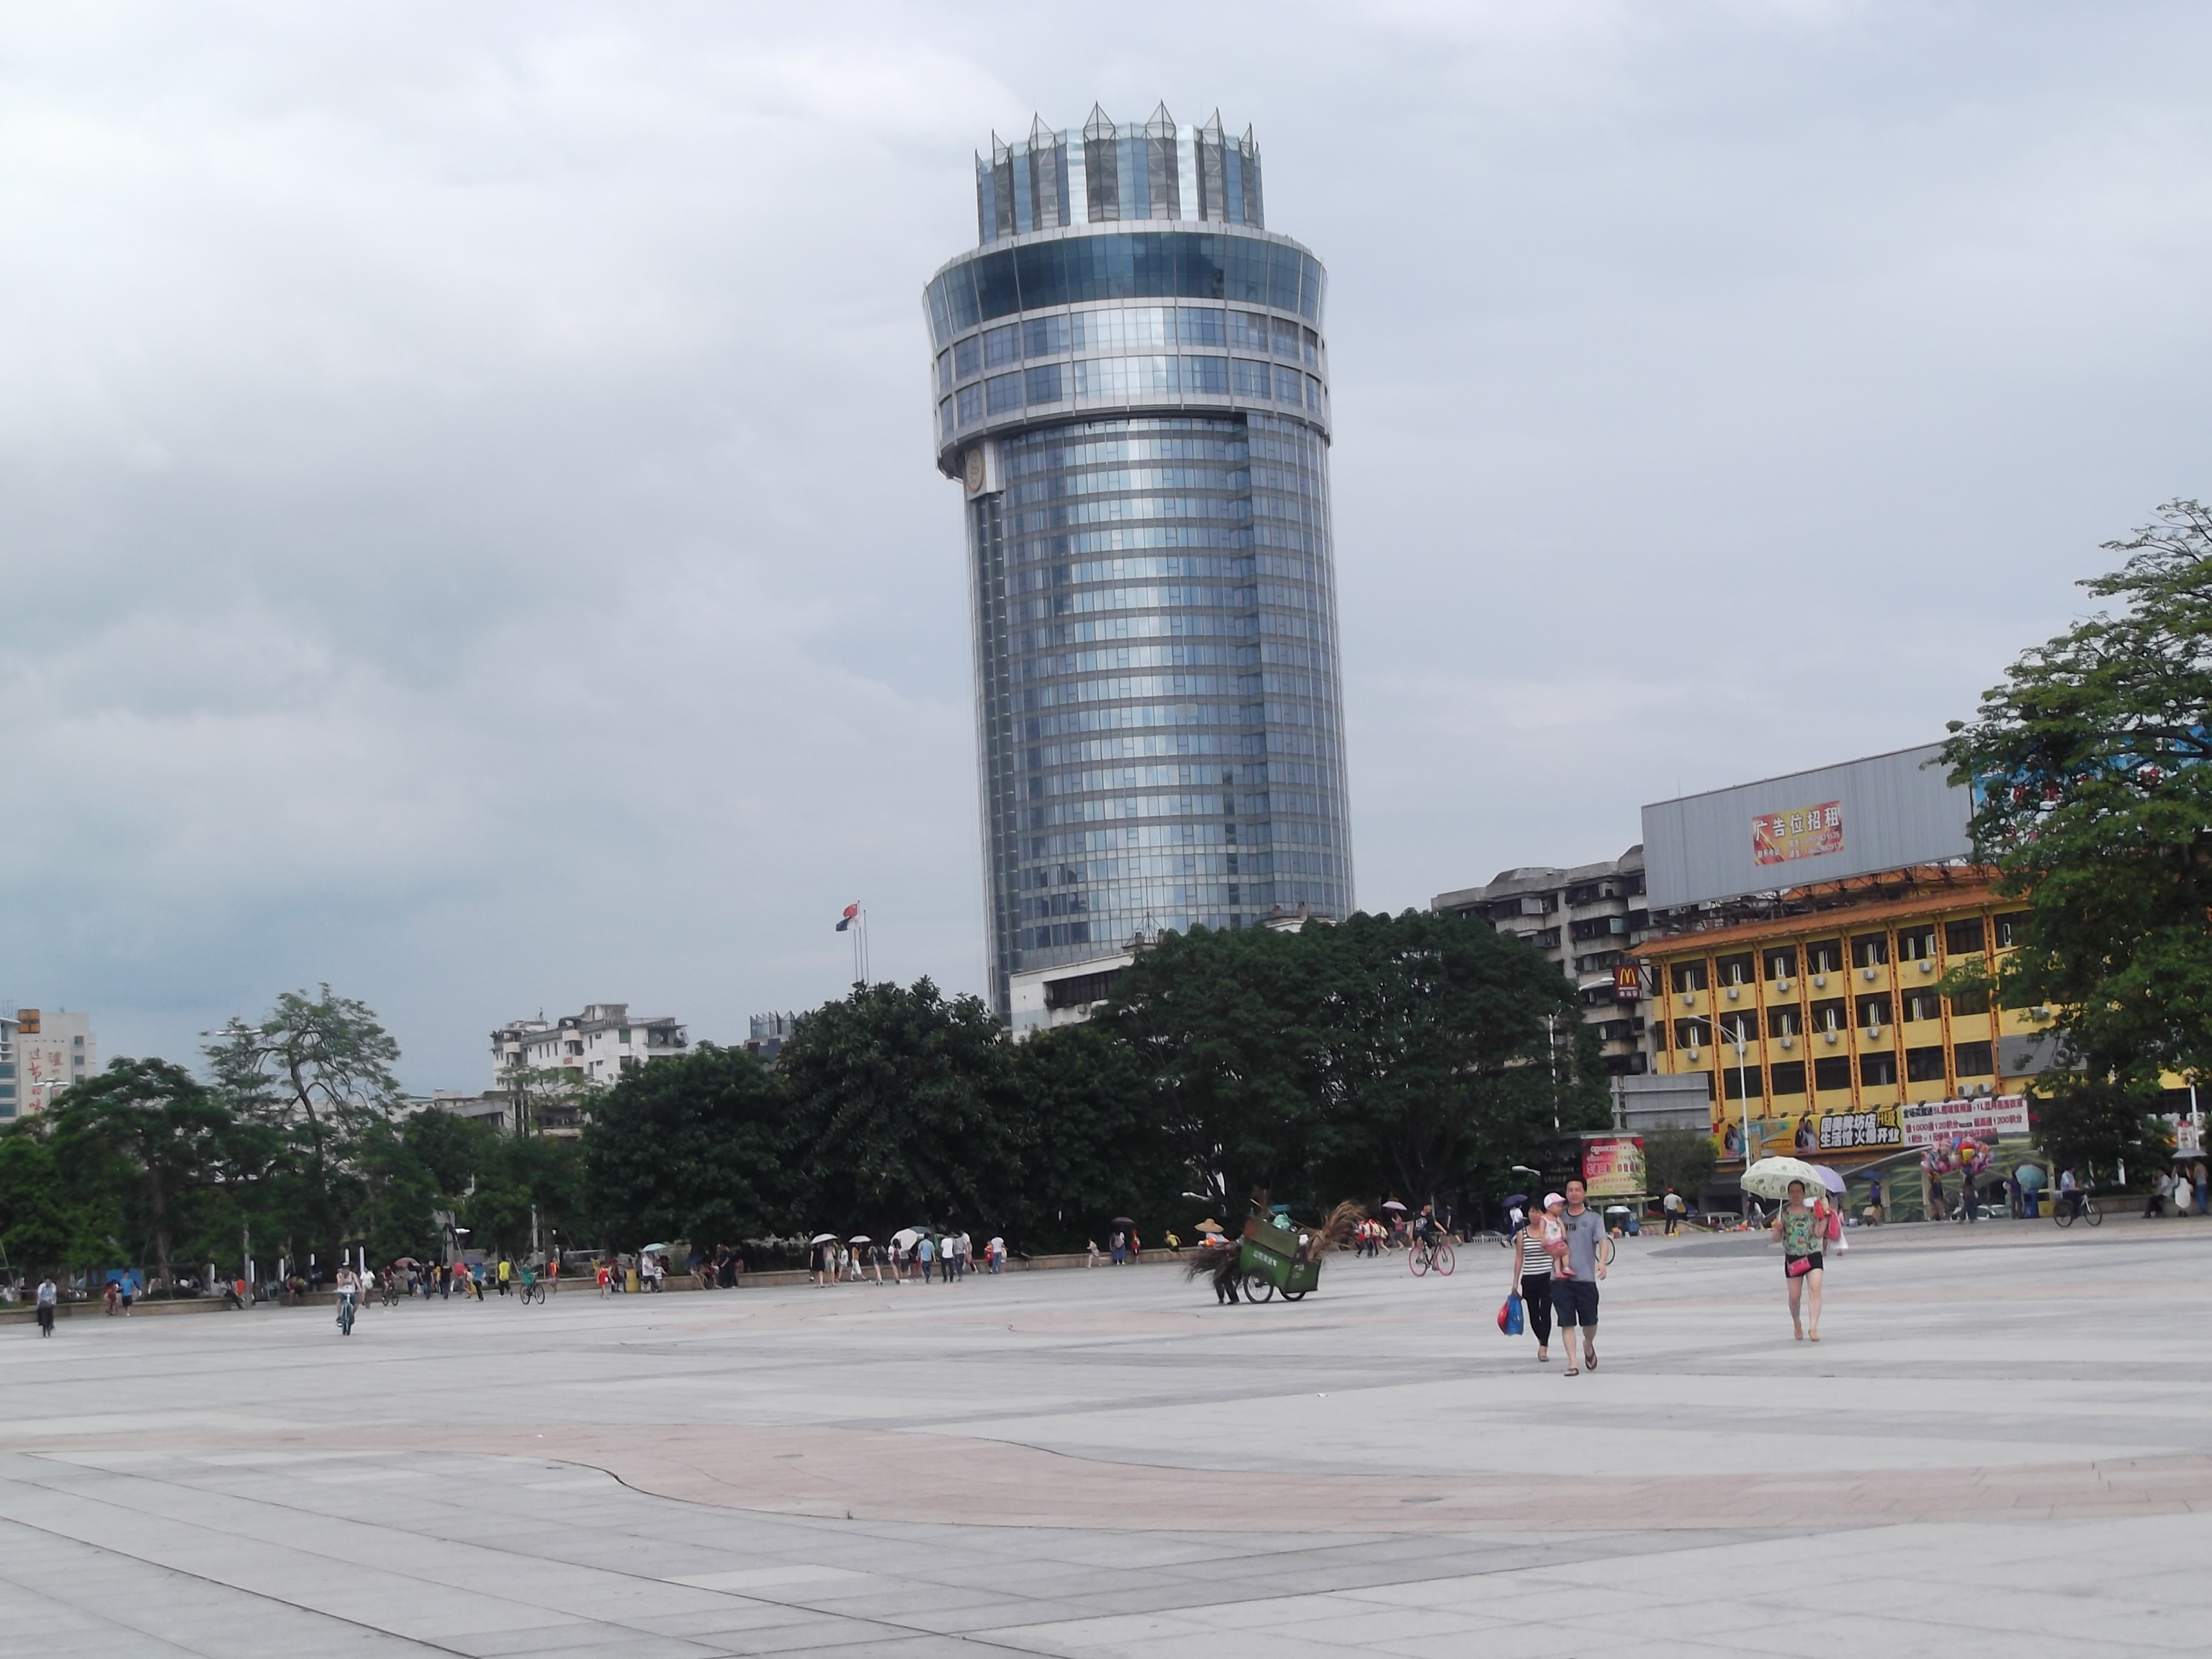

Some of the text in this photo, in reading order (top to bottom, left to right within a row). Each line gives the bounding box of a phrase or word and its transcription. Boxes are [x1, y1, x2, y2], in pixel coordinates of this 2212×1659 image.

[1755, 806, 1840, 841] 广告位招租
